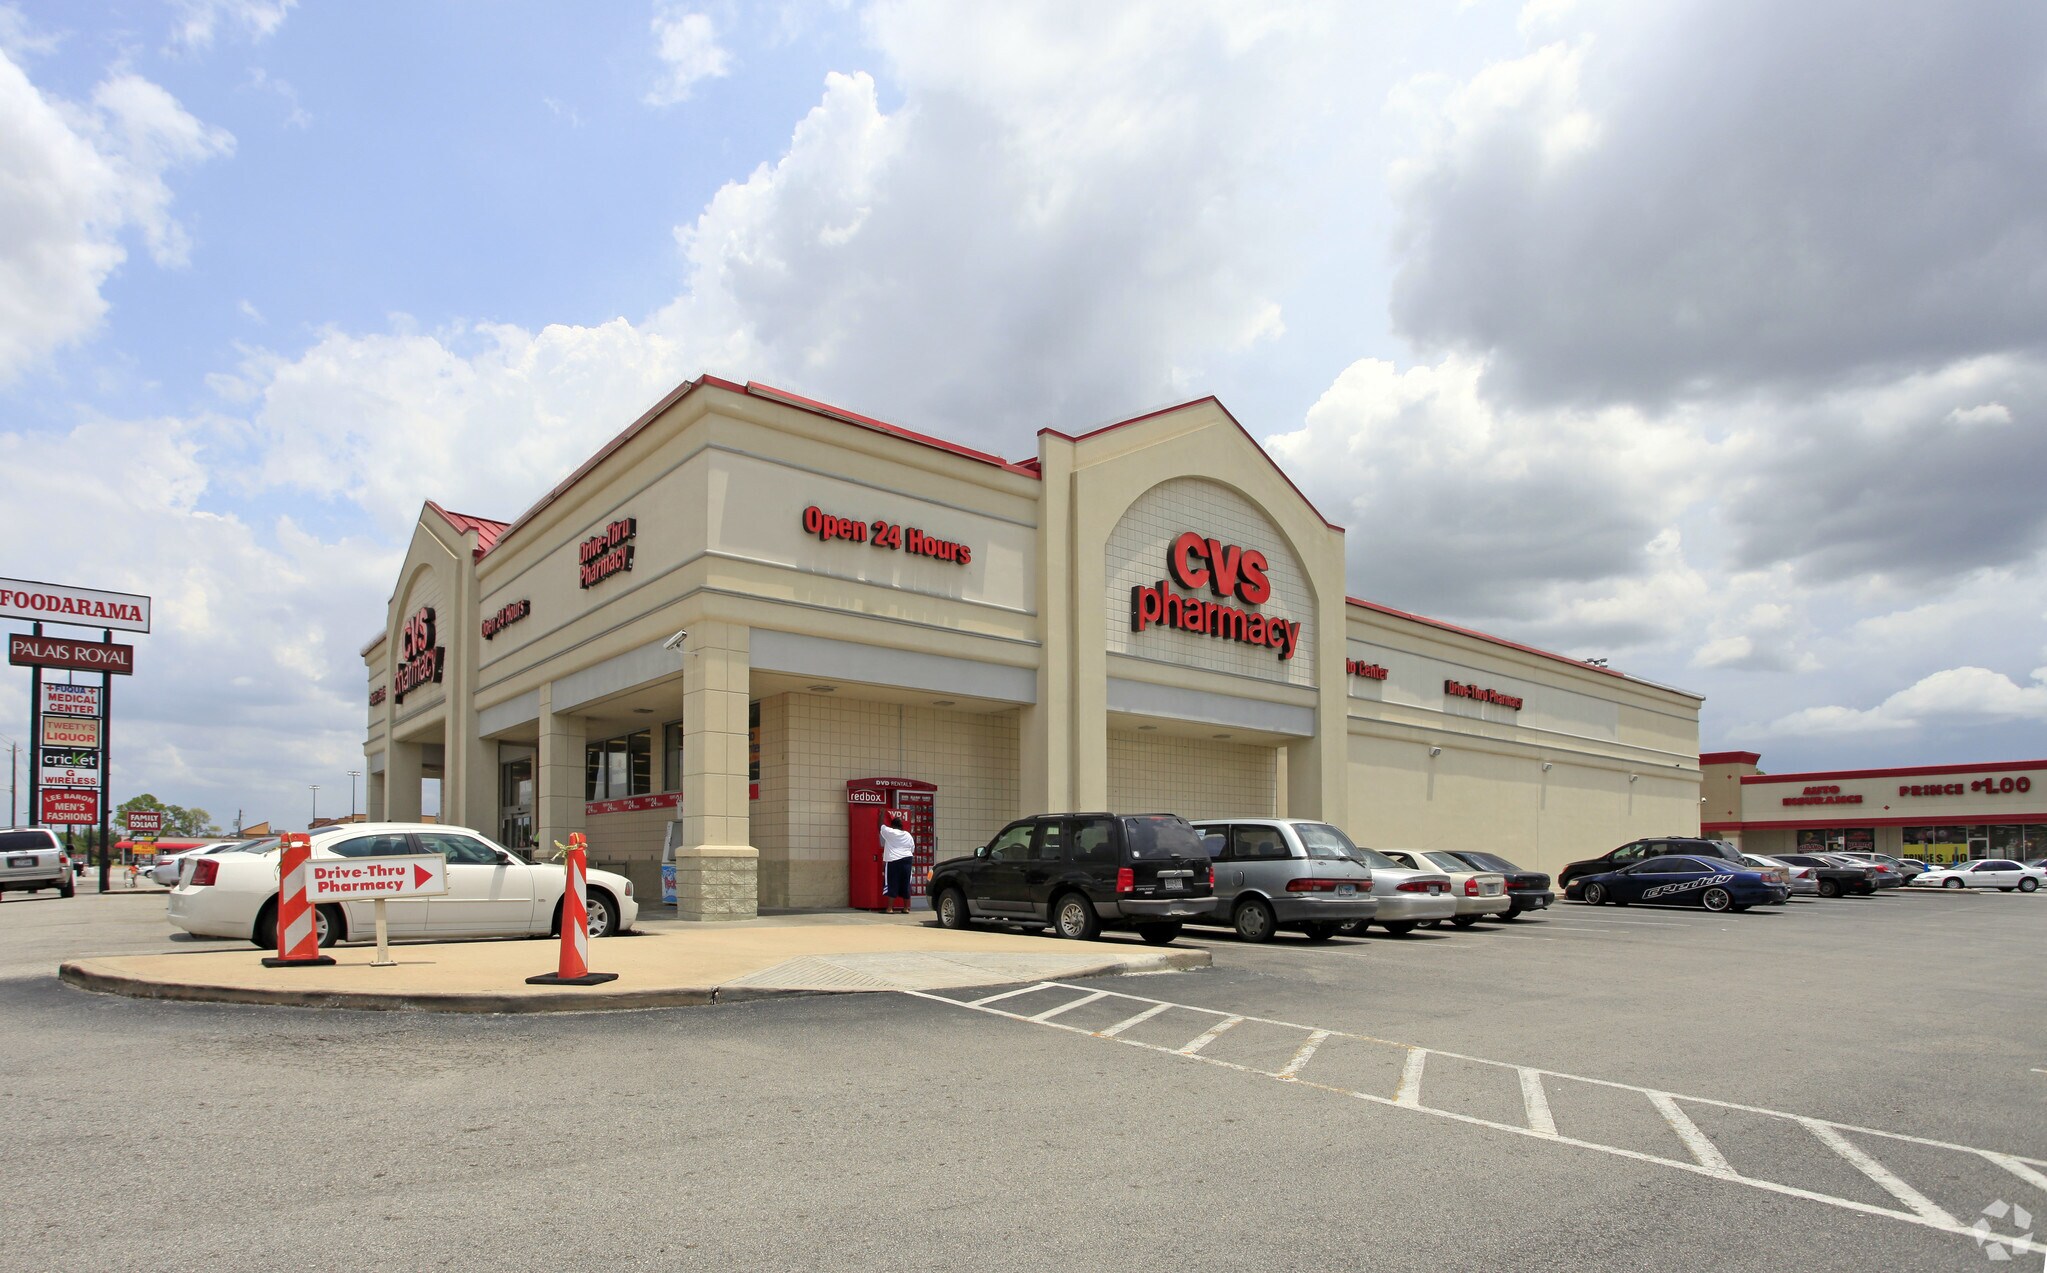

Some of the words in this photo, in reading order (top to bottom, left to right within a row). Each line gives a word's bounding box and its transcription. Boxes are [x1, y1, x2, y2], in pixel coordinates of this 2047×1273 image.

[579, 518, 636, 565] Drive-Thru
[803, 505, 867, 542] Open
[870, 520, 902, 550] 24
[905, 527, 971, 565] Hours
[579, 544, 635, 589] Pharmacy
[1167, 531, 1271, 605] CVS
[0, 589, 143, 622] FOODARAMA
[1131, 580, 1301, 661] pharmacy
[402, 607, 436, 662] CVS
[12, 640, 70, 660] PALAIS
[74, 646, 129, 665] ROYAL
[54, 685, 86, 694] FUQUA
[1445, 680, 1488, 702] Drive-Thru
[1487, 689, 1523, 711] Pharmacy
[48, 693, 97, 704] MEDICAL
[49, 703, 94, 714] CENTER
[47, 721, 96, 732] TWEETY'S
[46, 732, 96, 742] LIQUOR
[44, 752, 96, 766] cricket
[66, 769, 75, 777] G
[45, 776, 96, 785] WIRELESS
[1899, 783, 1964, 797] PRINCE
[45, 794, 61, 803] LEE
[64, 793, 95, 804] BARON
[851, 792, 881, 802] redbox
[55, 802, 85, 811] MEN'S
[46, 812, 93, 821] FASHIONS
[314, 864, 406, 880] Drive-Thru
[317, 880, 404, 893] Pharmacy
